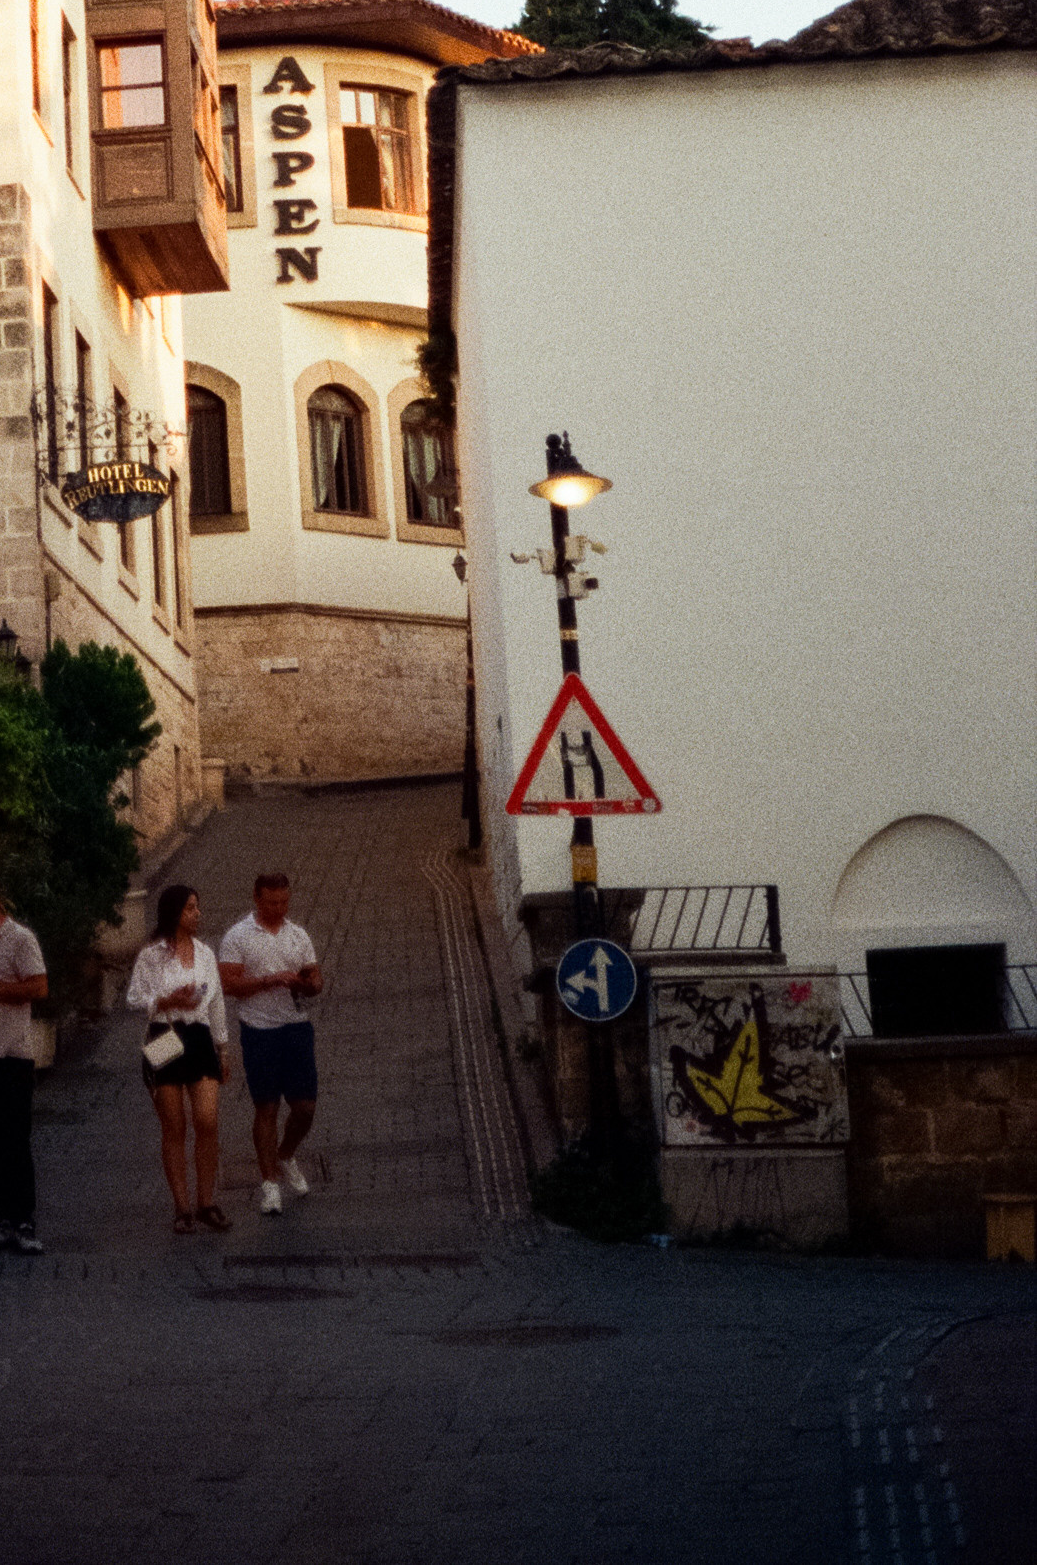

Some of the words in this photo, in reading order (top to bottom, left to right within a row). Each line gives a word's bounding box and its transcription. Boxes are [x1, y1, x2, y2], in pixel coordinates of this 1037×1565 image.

[263, 56, 322, 285] ASPEN
[88, 463, 144, 483] HOTEL
[65, 479, 169, 510] REUTLINGEN
